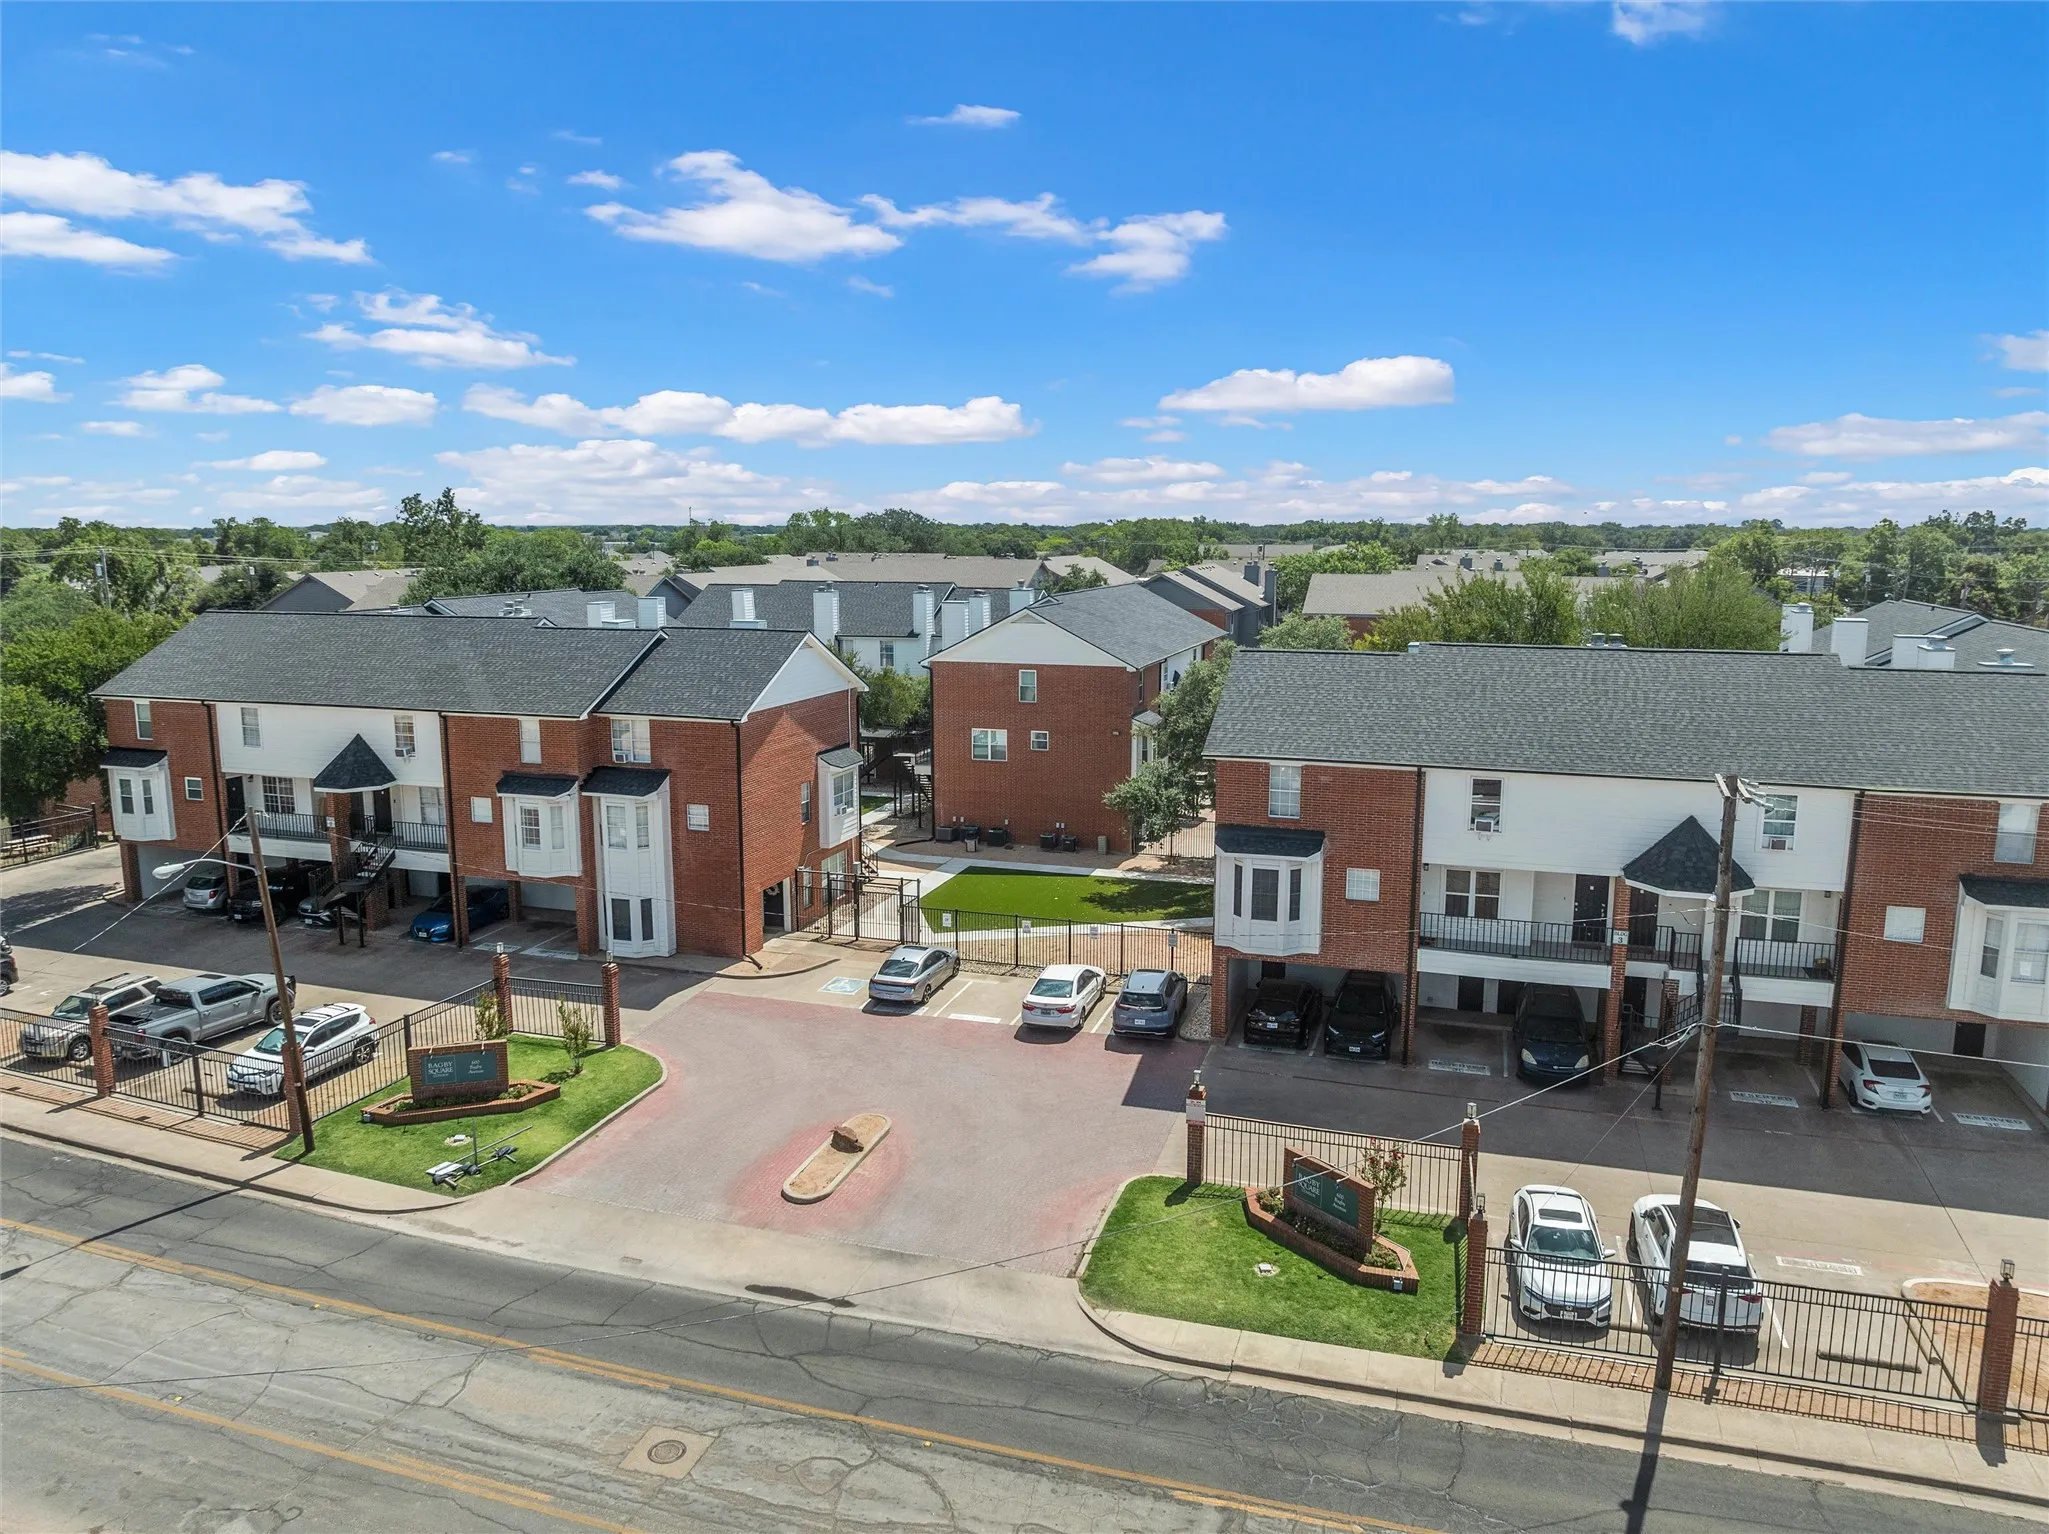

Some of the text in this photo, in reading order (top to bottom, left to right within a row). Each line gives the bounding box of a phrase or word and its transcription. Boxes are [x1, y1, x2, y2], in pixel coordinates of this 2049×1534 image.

[428, 1061, 453, 1069] BAGBY
[428, 1067, 454, 1075] SQUARE
[1732, 1092, 1793, 1102] RESERVED
[1957, 1113, 2024, 1125] RESERVED
